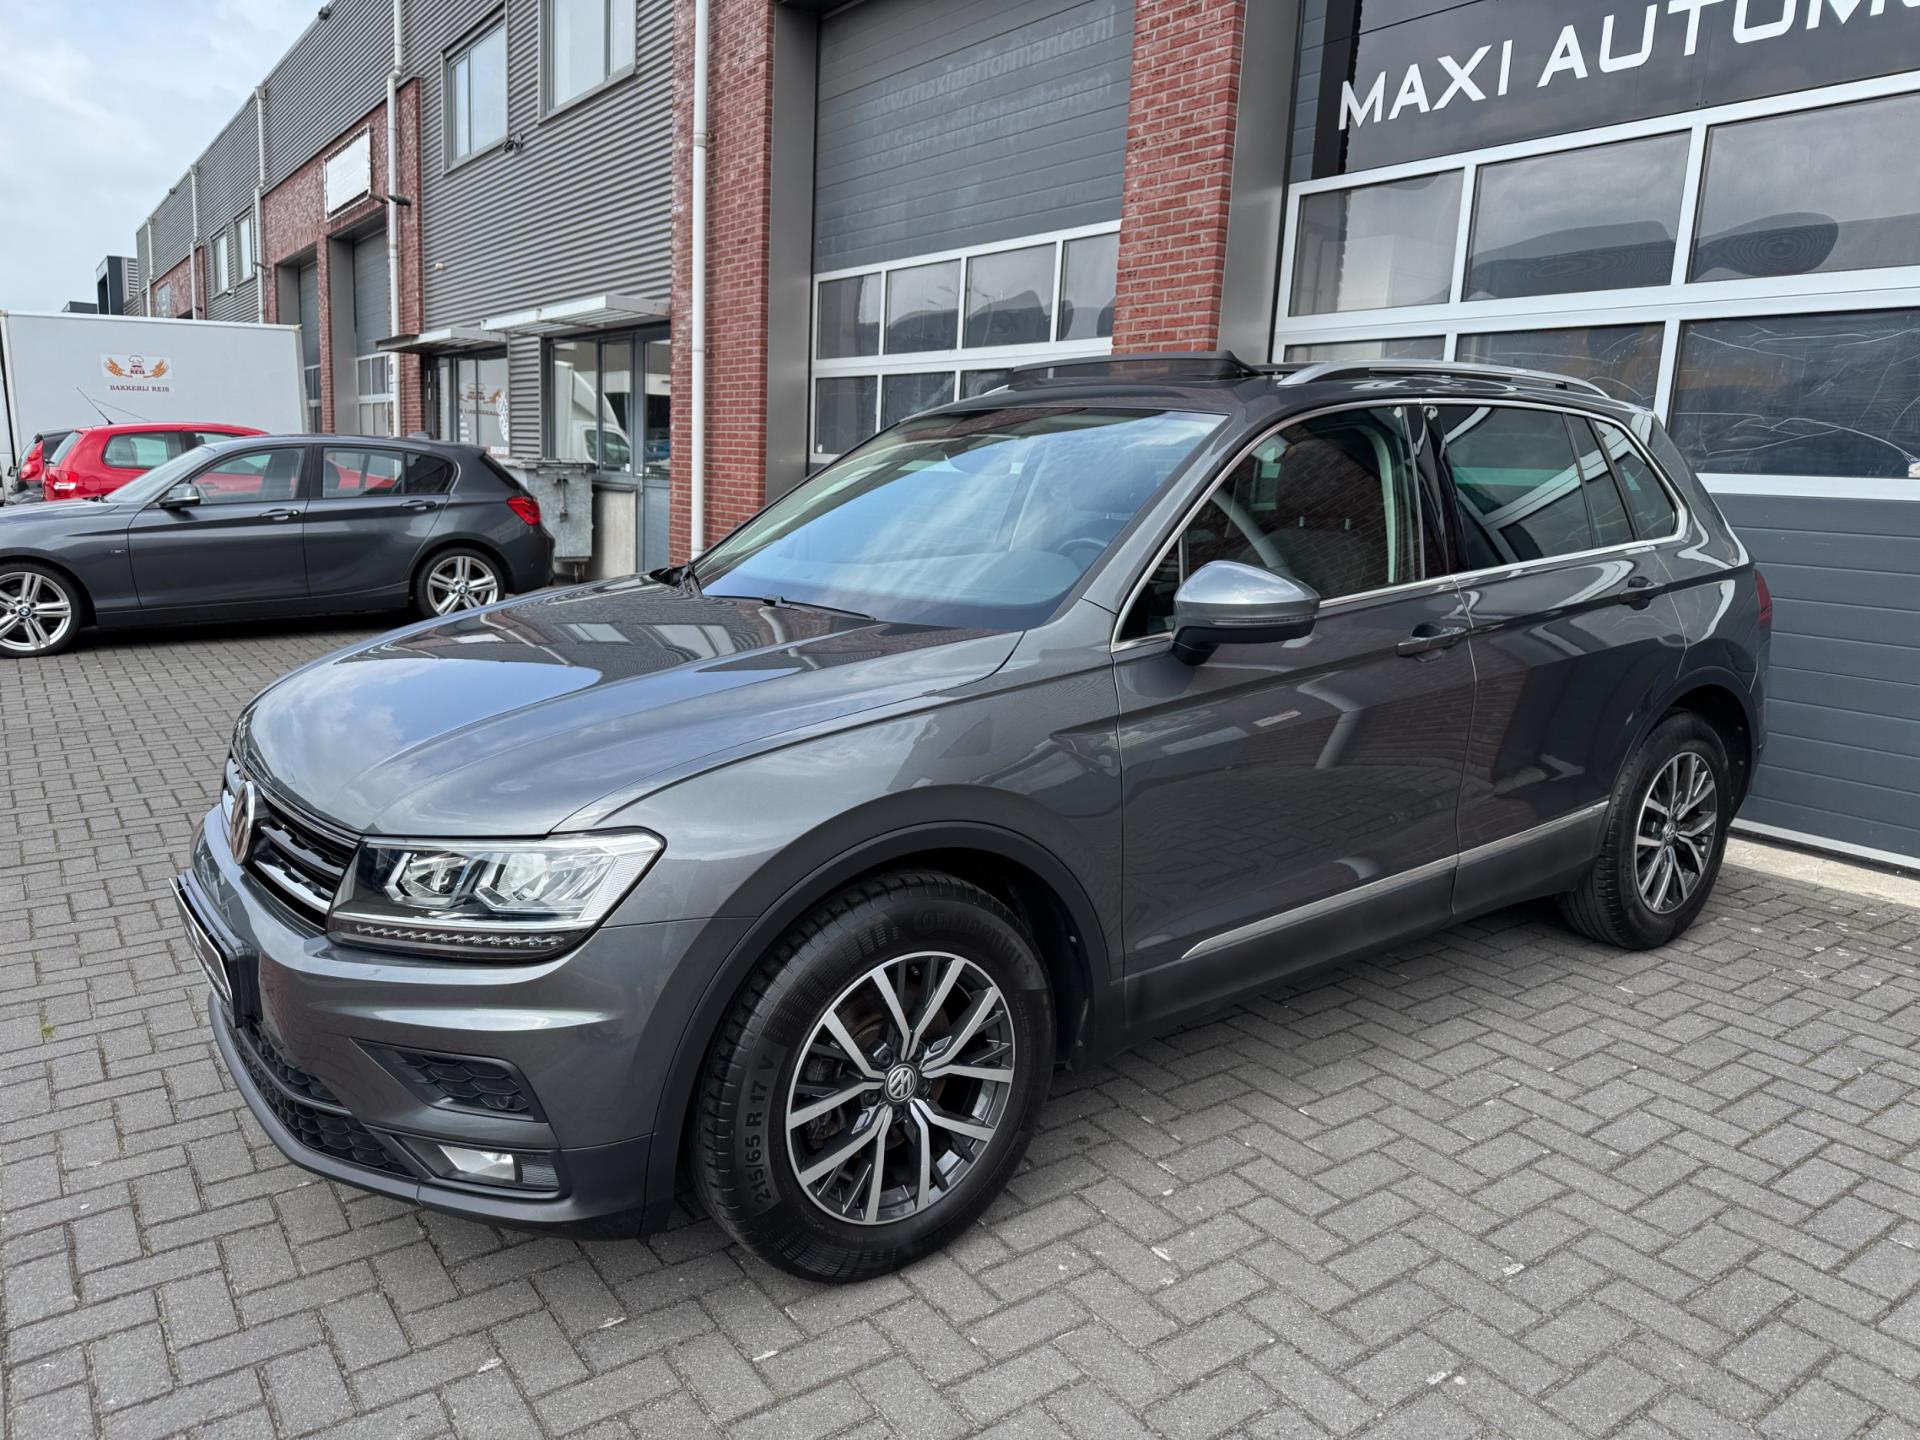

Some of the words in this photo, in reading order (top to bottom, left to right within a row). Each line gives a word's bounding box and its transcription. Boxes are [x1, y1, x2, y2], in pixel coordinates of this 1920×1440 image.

[1338, 38, 1514, 131] MAXI
[1537, 0, 1920, 88] AUTO
[110, 384, 149, 392] BAKKERIJ
[757, 1055, 775, 1070] V
[750, 1079, 768, 1105] 17
[745, 1111, 763, 1127] R
[744, 1134, 772, 1204] 215/65
